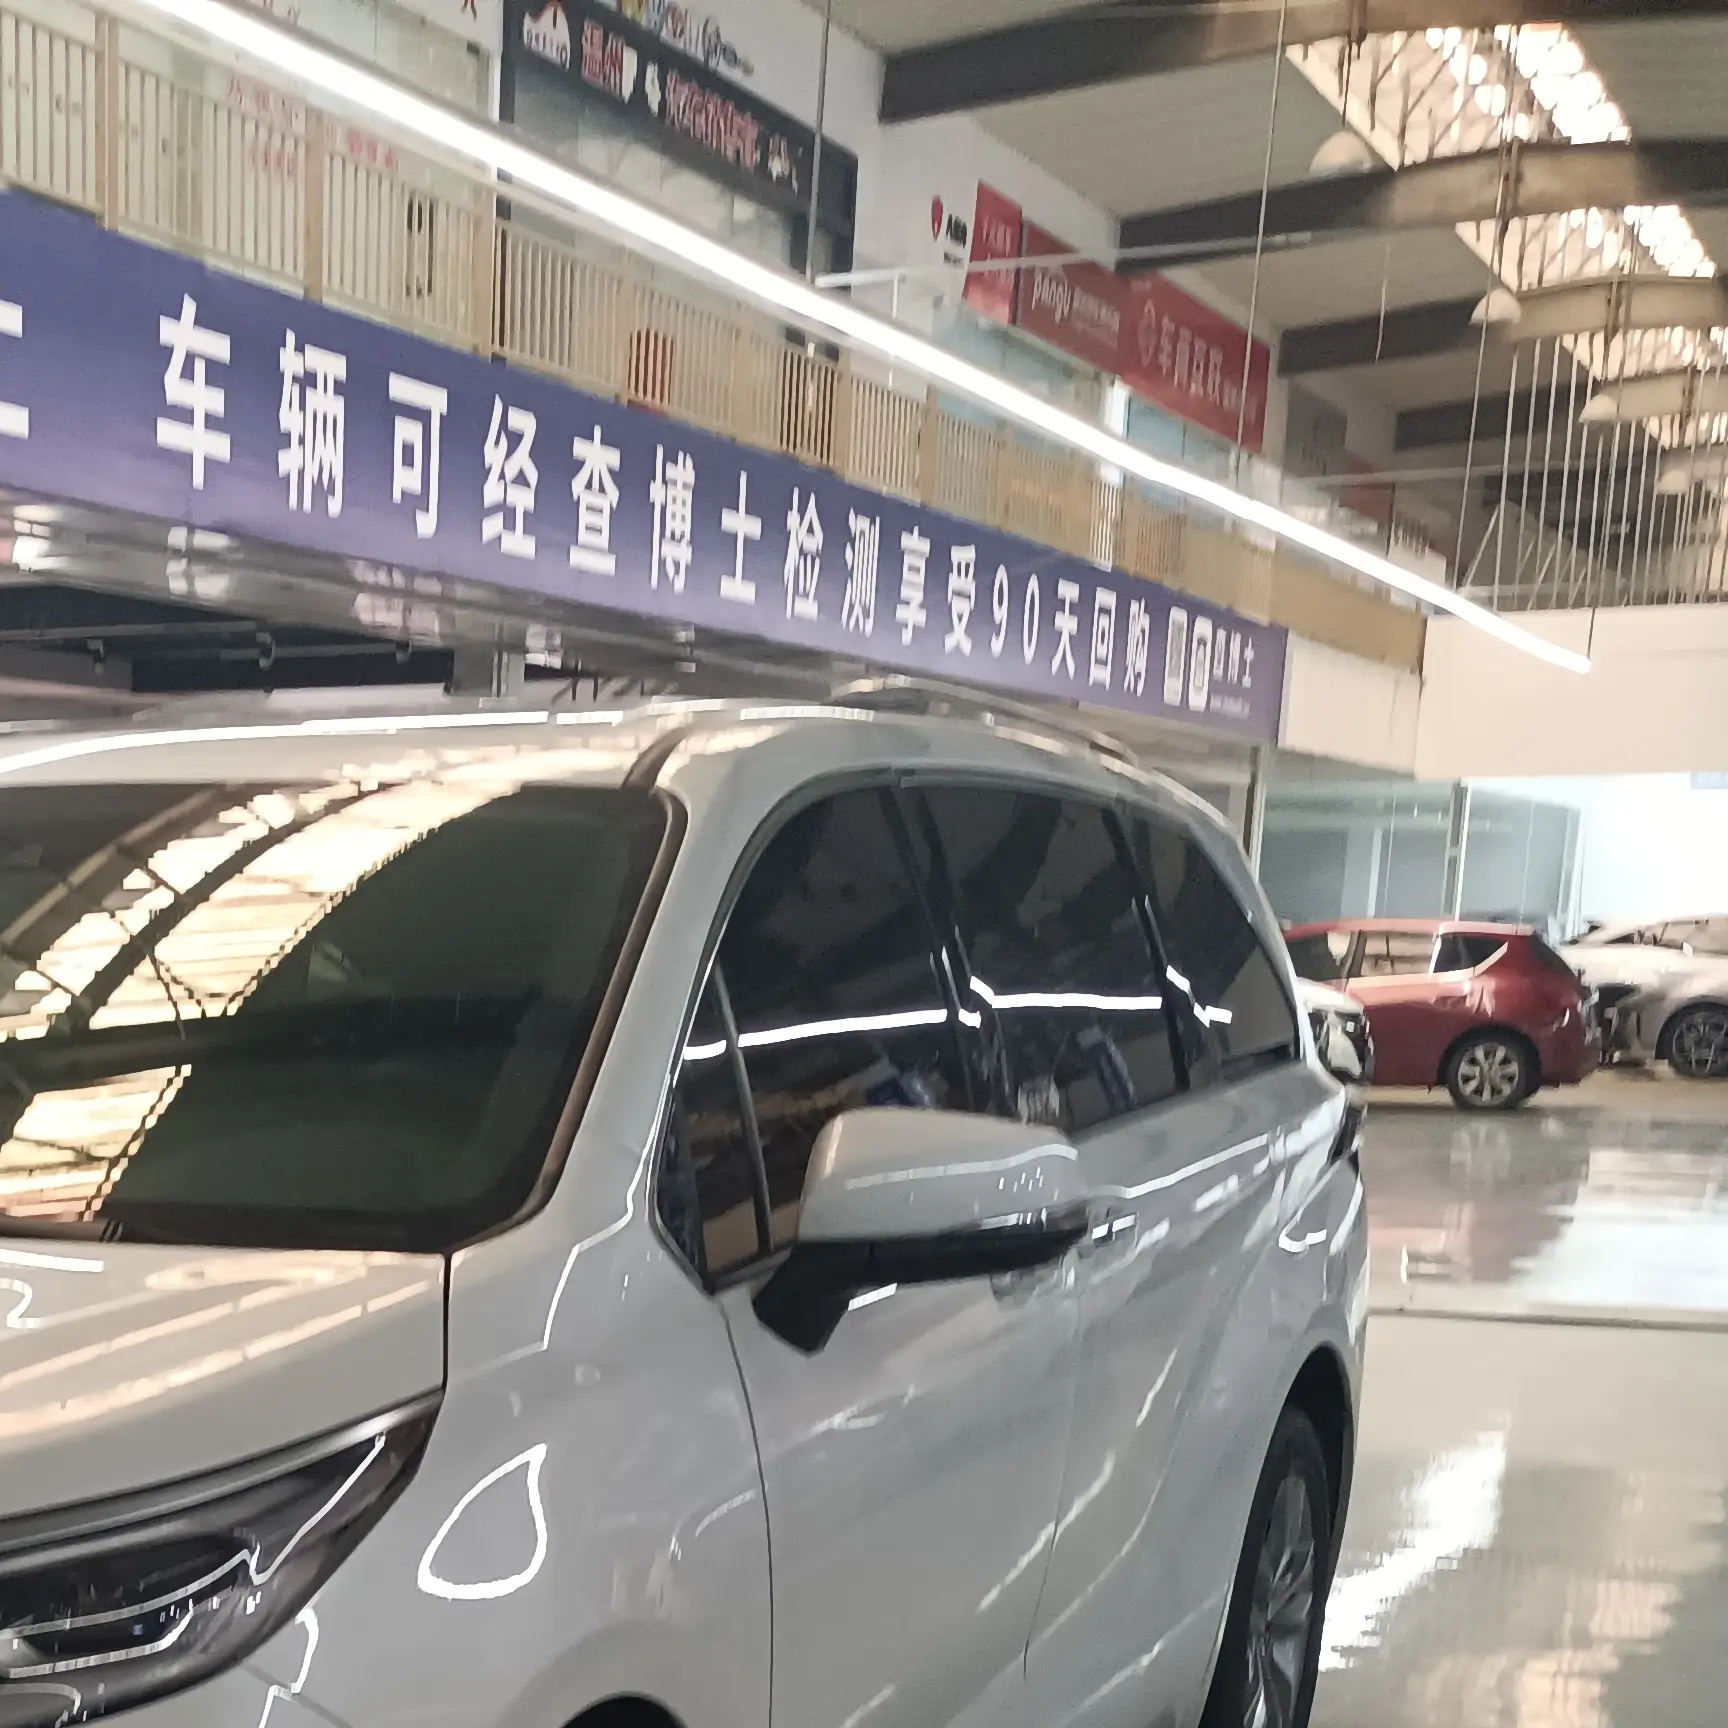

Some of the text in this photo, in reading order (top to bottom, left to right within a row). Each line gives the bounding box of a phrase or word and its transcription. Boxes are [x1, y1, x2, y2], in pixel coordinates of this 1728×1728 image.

[156, 293, 1150, 697] 车辆可经查博士检测享受90天回购
